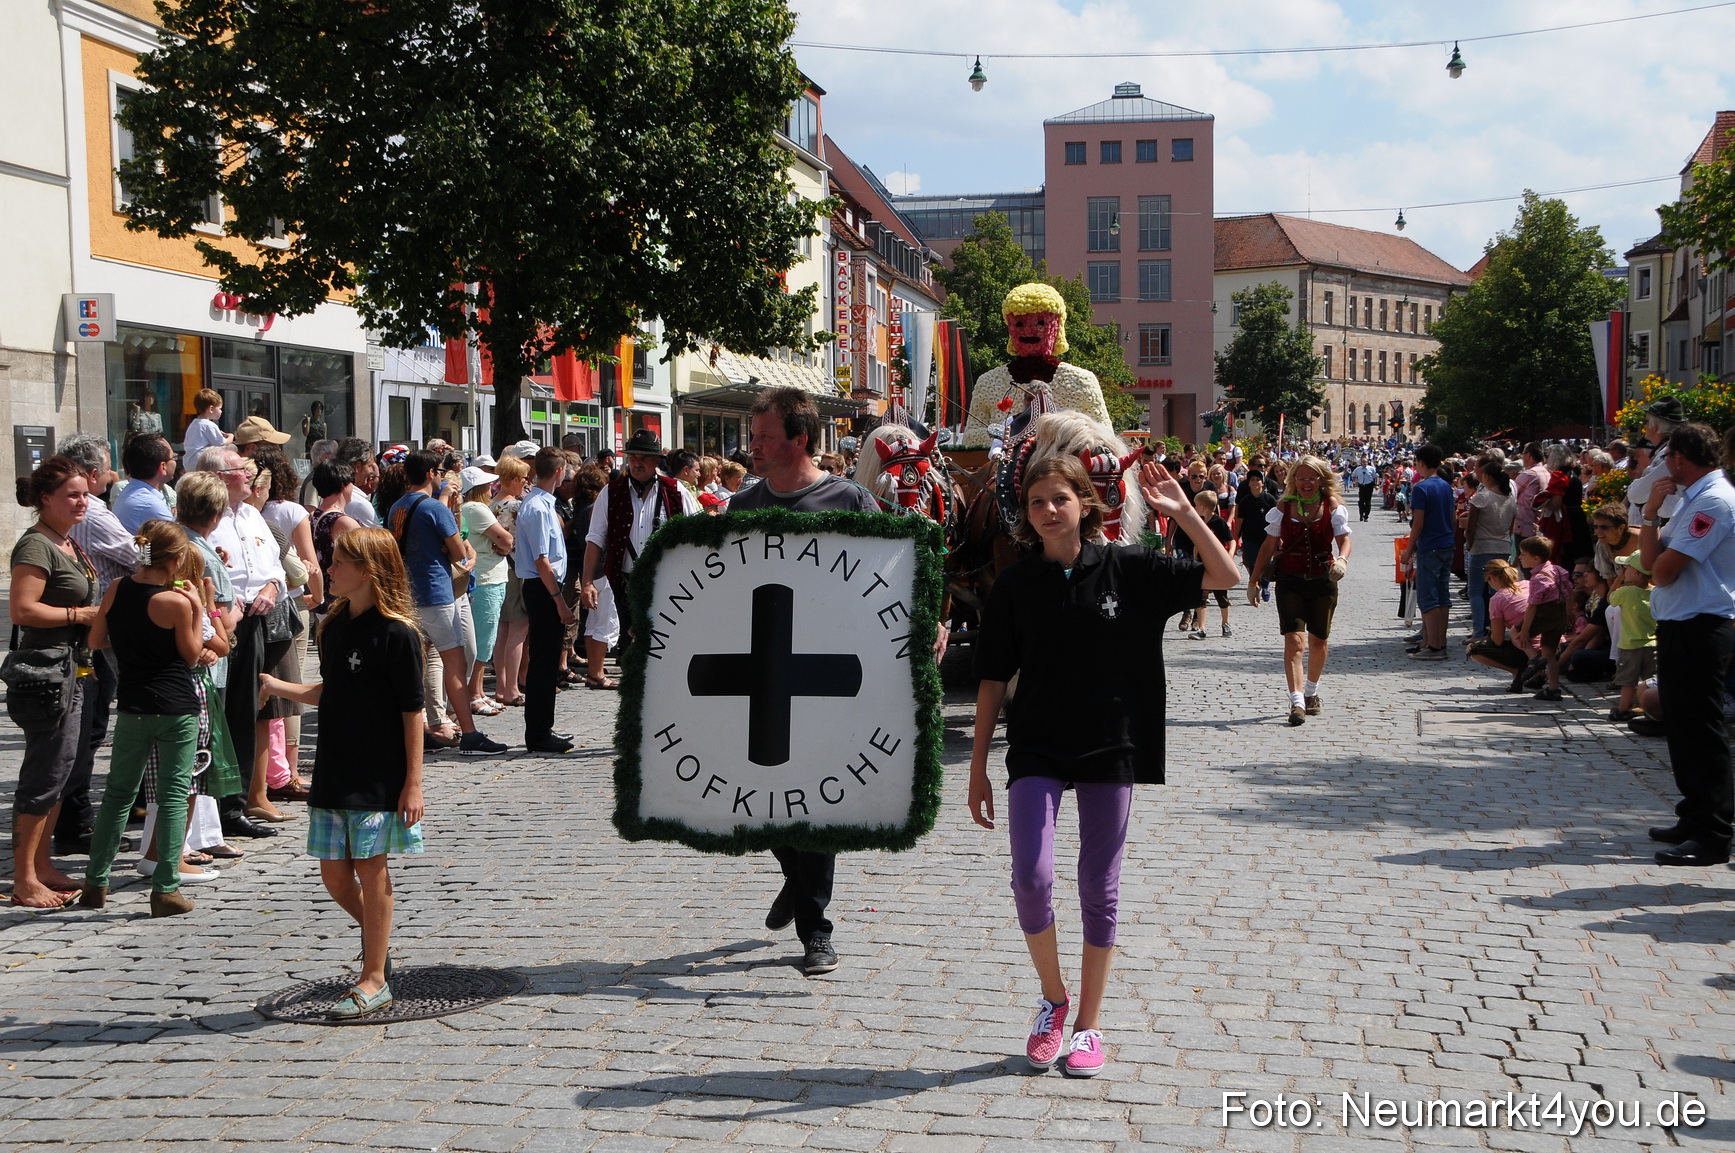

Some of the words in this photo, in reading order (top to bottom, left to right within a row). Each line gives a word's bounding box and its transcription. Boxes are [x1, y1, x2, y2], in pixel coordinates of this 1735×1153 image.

[891, 299, 902, 407] METZGREI
[647, 532, 913, 660] MINISTRANTEN
[654, 722, 901, 819] HOFKIRCHE
